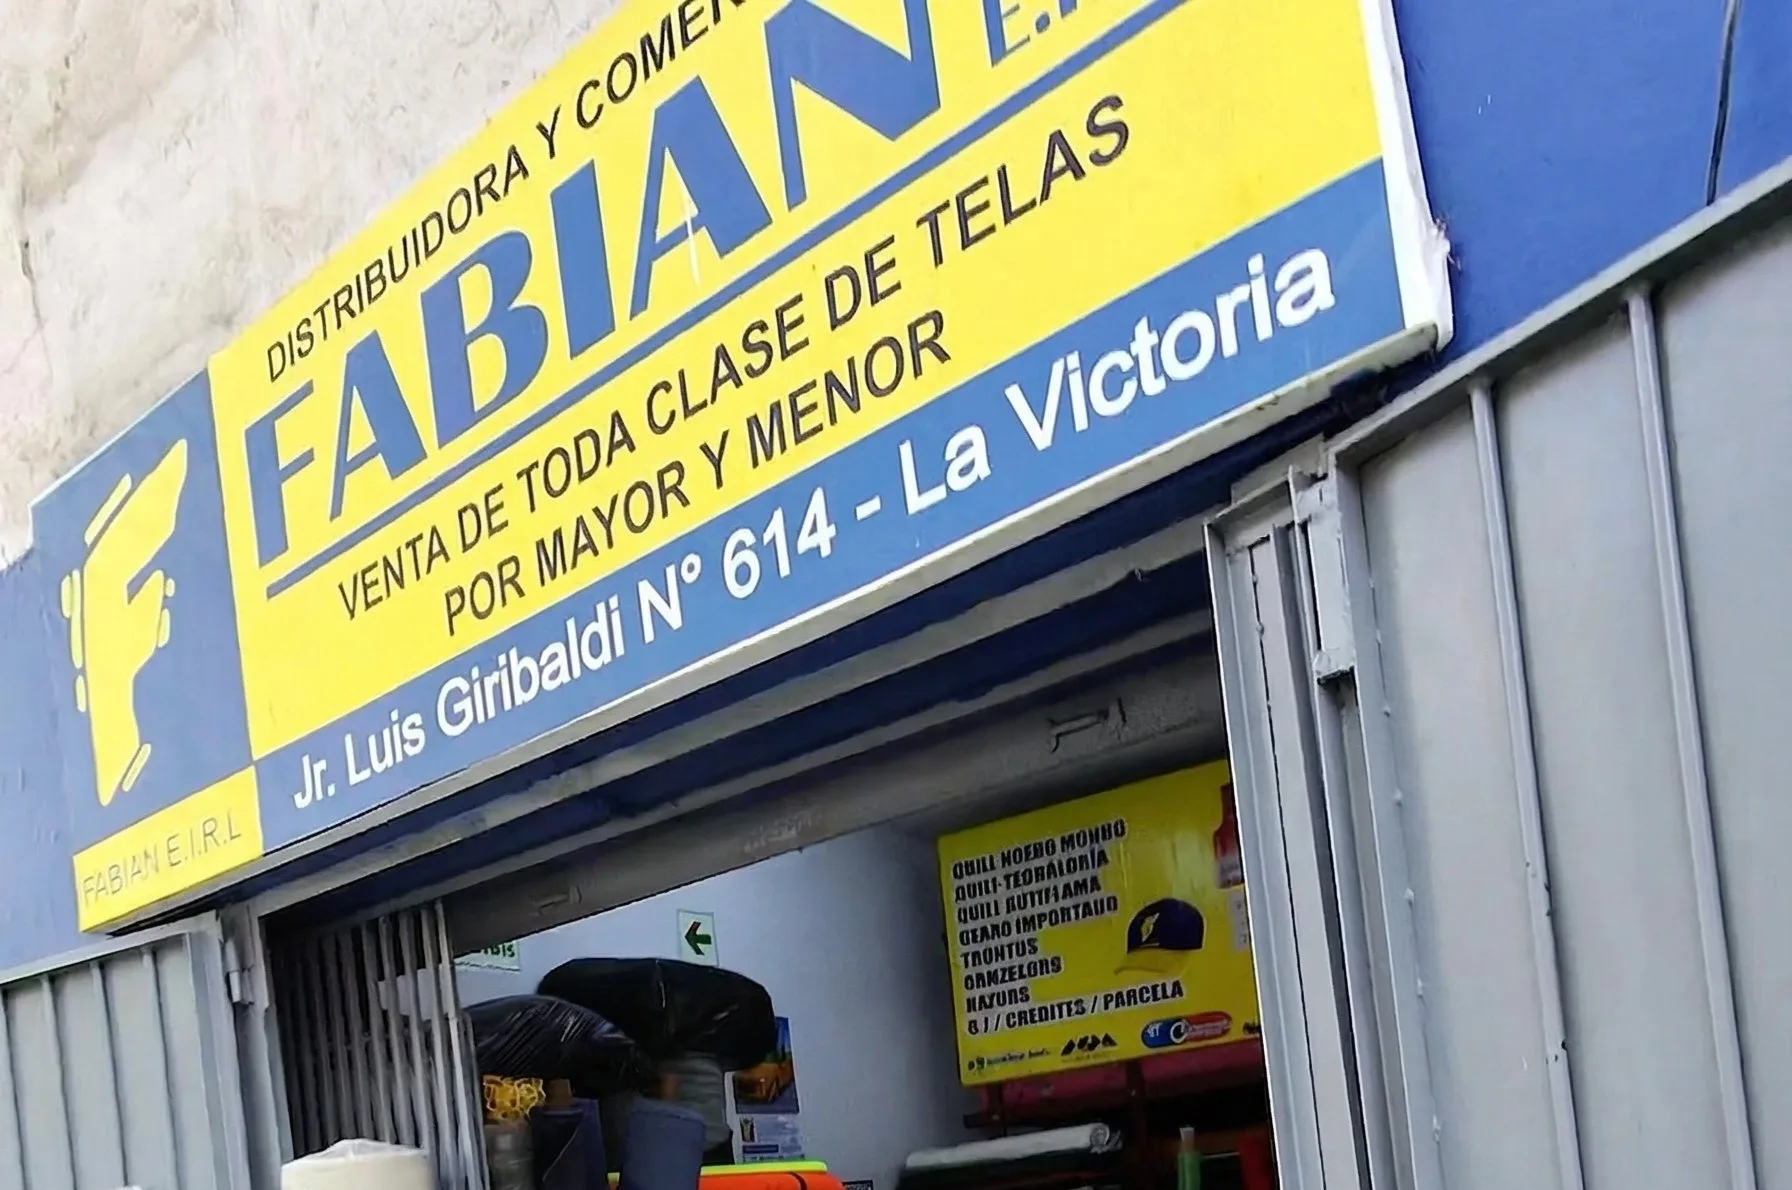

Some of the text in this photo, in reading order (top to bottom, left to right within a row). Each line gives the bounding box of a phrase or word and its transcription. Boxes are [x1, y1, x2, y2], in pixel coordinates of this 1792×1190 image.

[244, 0, 941, 568] FABIAN
[266, 145, 529, 382] DISTRIBUIDORA
[536, 105, 561, 159] Y
[338, 94, 1131, 621] VENTA DE TODA CLASE DE TELAS
[293, 753, 336, 808] Jr.
[344, 708, 425, 786] Luis
[437, 594, 626, 737] Giribaldi
[721, 486, 837, 600] 614
[900, 424, 992, 515] La
[1005, 249, 1336, 452] Victoria
[445, 309, 951, 636] POR MAYOR Y MENOR
[83, 844, 160, 908] FABIAN
